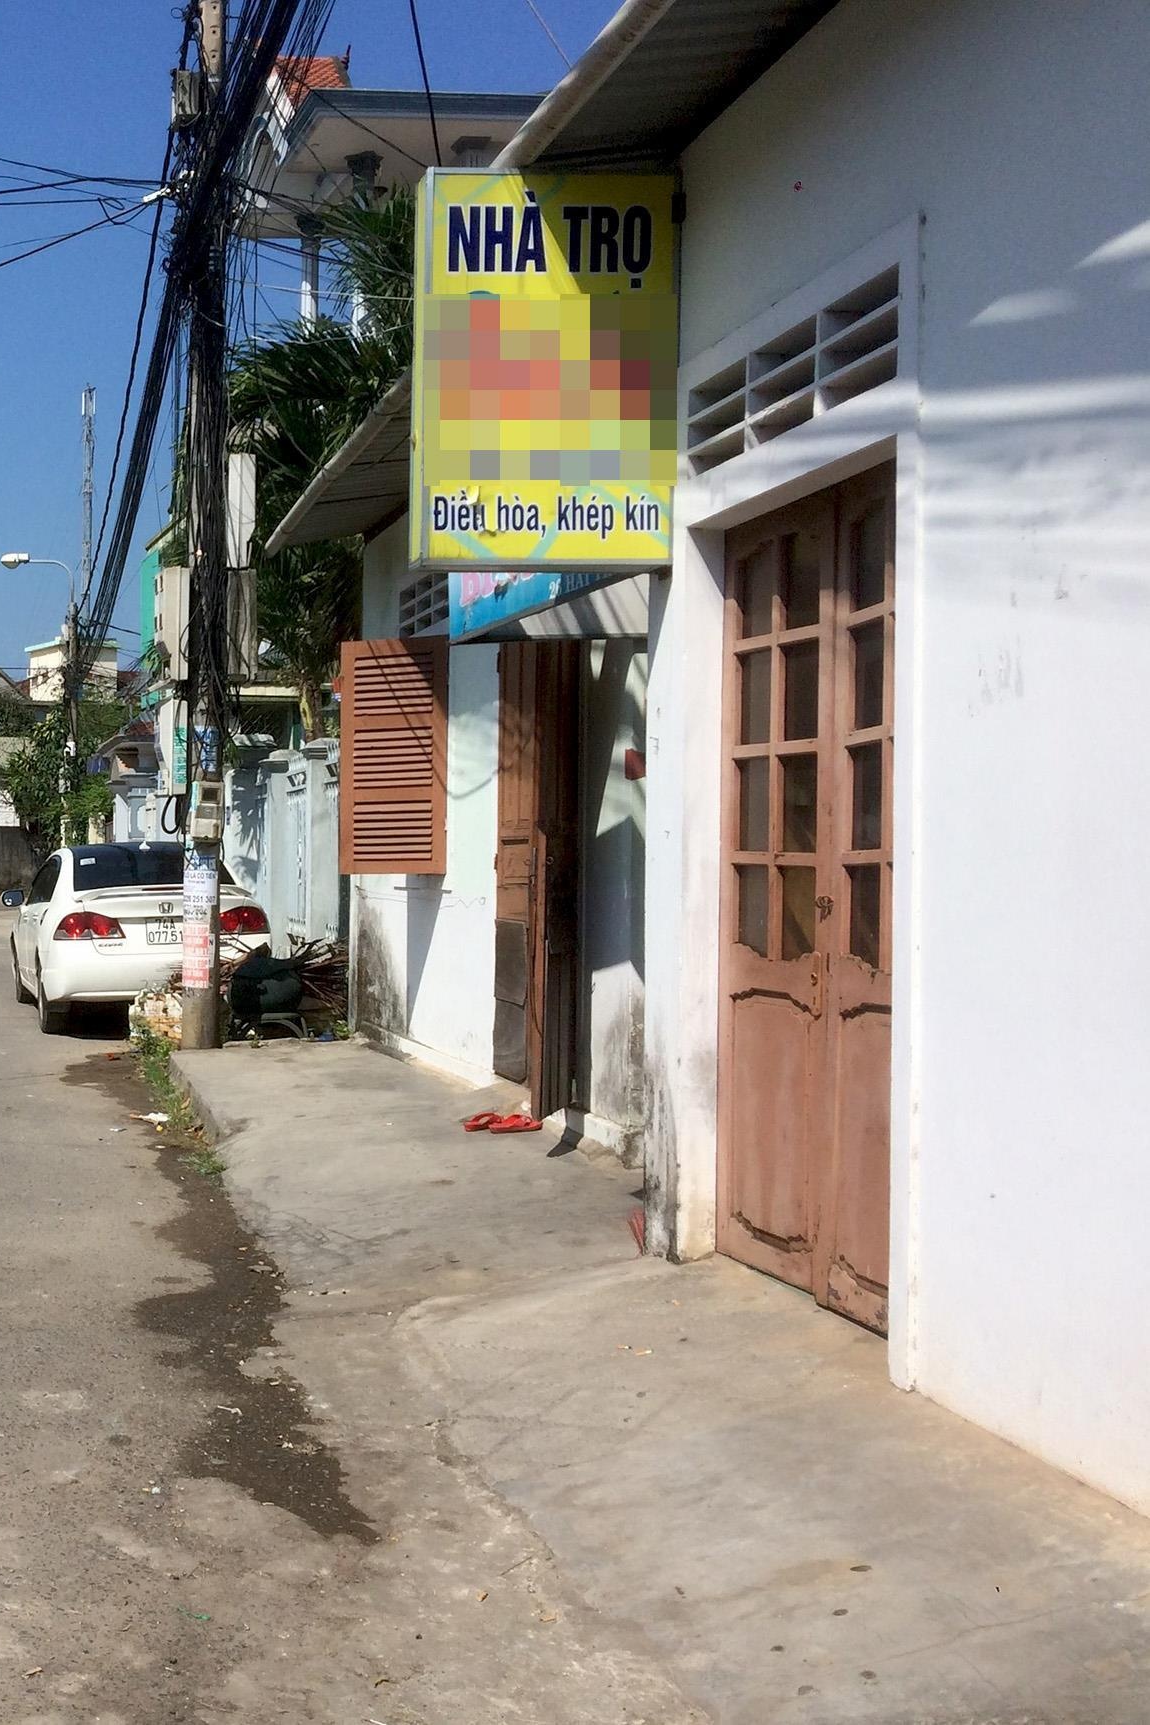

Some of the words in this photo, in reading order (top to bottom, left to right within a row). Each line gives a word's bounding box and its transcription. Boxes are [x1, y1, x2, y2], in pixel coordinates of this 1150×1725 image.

[447, 191, 547, 273] NHÀ
[563, 205, 652, 290] TRỌ
[497, 495, 547, 538] hòa,
[557, 495, 614, 540] khép
[625, 495, 659, 532] kín
[154, 918, 176, 930] 74A
